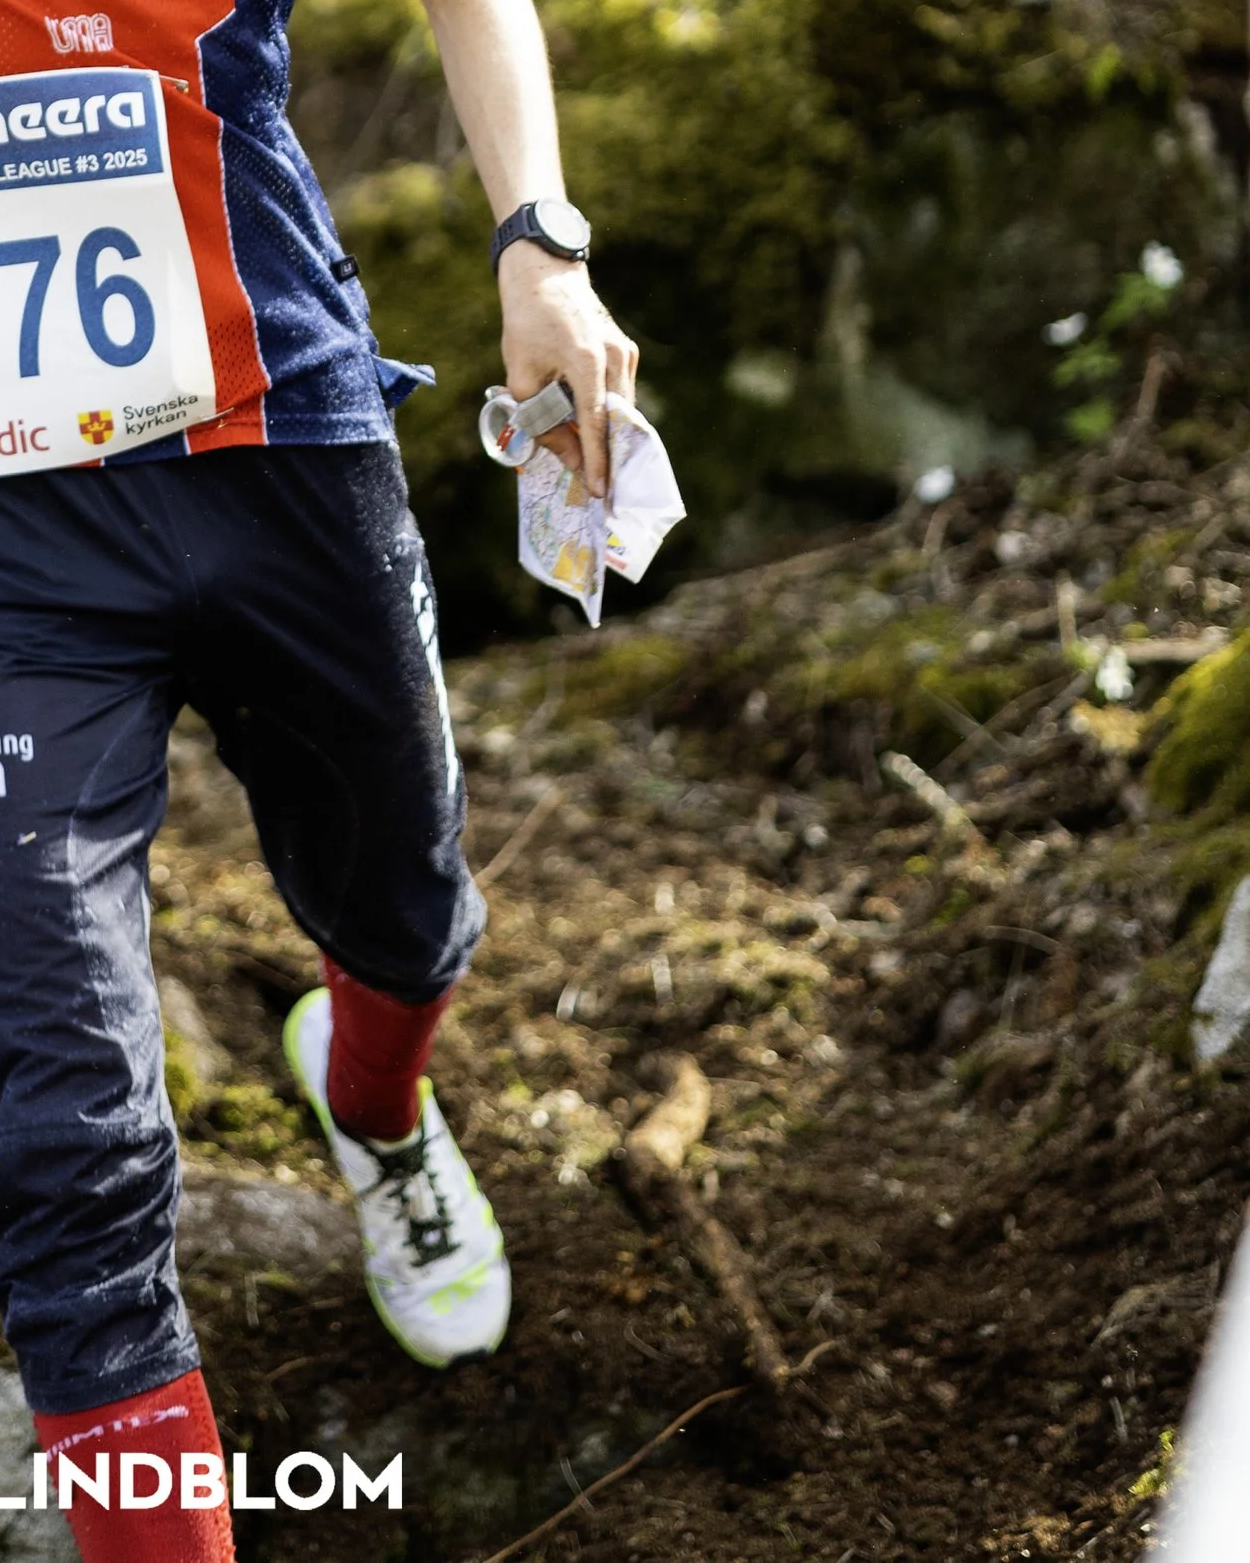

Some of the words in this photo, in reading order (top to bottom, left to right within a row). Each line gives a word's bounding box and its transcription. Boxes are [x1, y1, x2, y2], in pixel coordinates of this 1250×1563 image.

[76, 153, 99, 173] #3
[102, 148, 148, 170] 2025
[123, 394, 199, 421] Svenska
[125, 409, 187, 436] kyrkan
